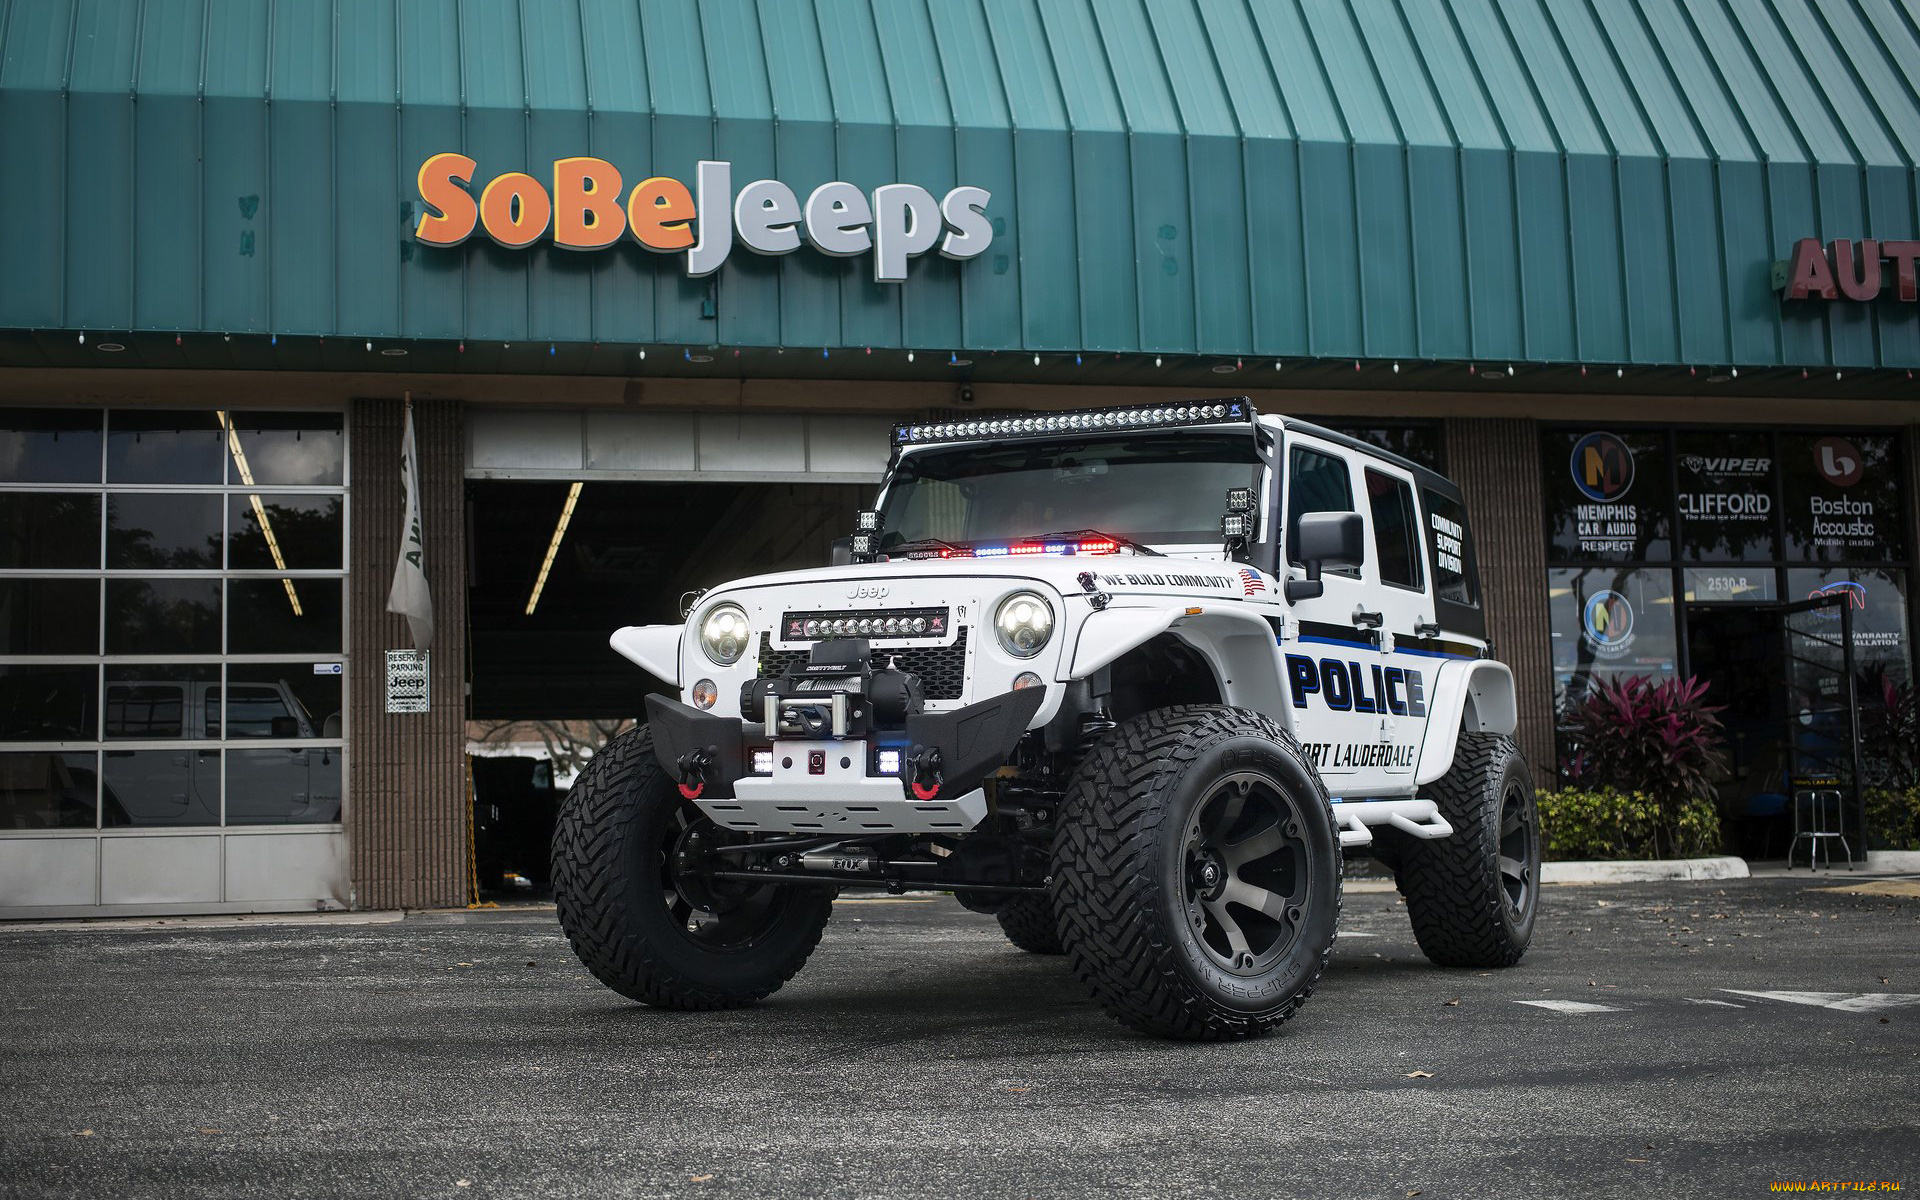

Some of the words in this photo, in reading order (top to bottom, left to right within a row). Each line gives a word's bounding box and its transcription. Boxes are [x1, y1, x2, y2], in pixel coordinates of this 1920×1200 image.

[415, 152, 994, 283] SoBeJeeps
[1783, 237, 1920, 302] AUT
[1704, 458, 1771, 471] VIPER
[1577, 504, 1637, 520] MEMPHIS
[1678, 493, 1771, 514] CLIFFORD
[1810, 494, 1873, 515] Boston
[1431, 512, 1463, 541] COMMUNITY
[1578, 522, 1600, 535] CAR
[1606, 522, 1637, 535] AUDIO
[1812, 515, 1875, 536] Accoustic
[1436, 532, 1462, 557] SUPPORT
[1581, 541, 1634, 552] RESPECT
[1438, 551, 1462, 575] DIVISION
[1126, 573, 1166, 586] BUILD
[846, 584, 890, 600] Jeep
[388, 653, 426, 662] RESERVD
[390, 663, 424, 671] PARKING
[390, 676, 425, 690] Jeep
[1284, 653, 1426, 718] POLICE
[1300, 743, 1332, 767] ORT
[1333, 743, 1415, 768] LAUDERDALE
